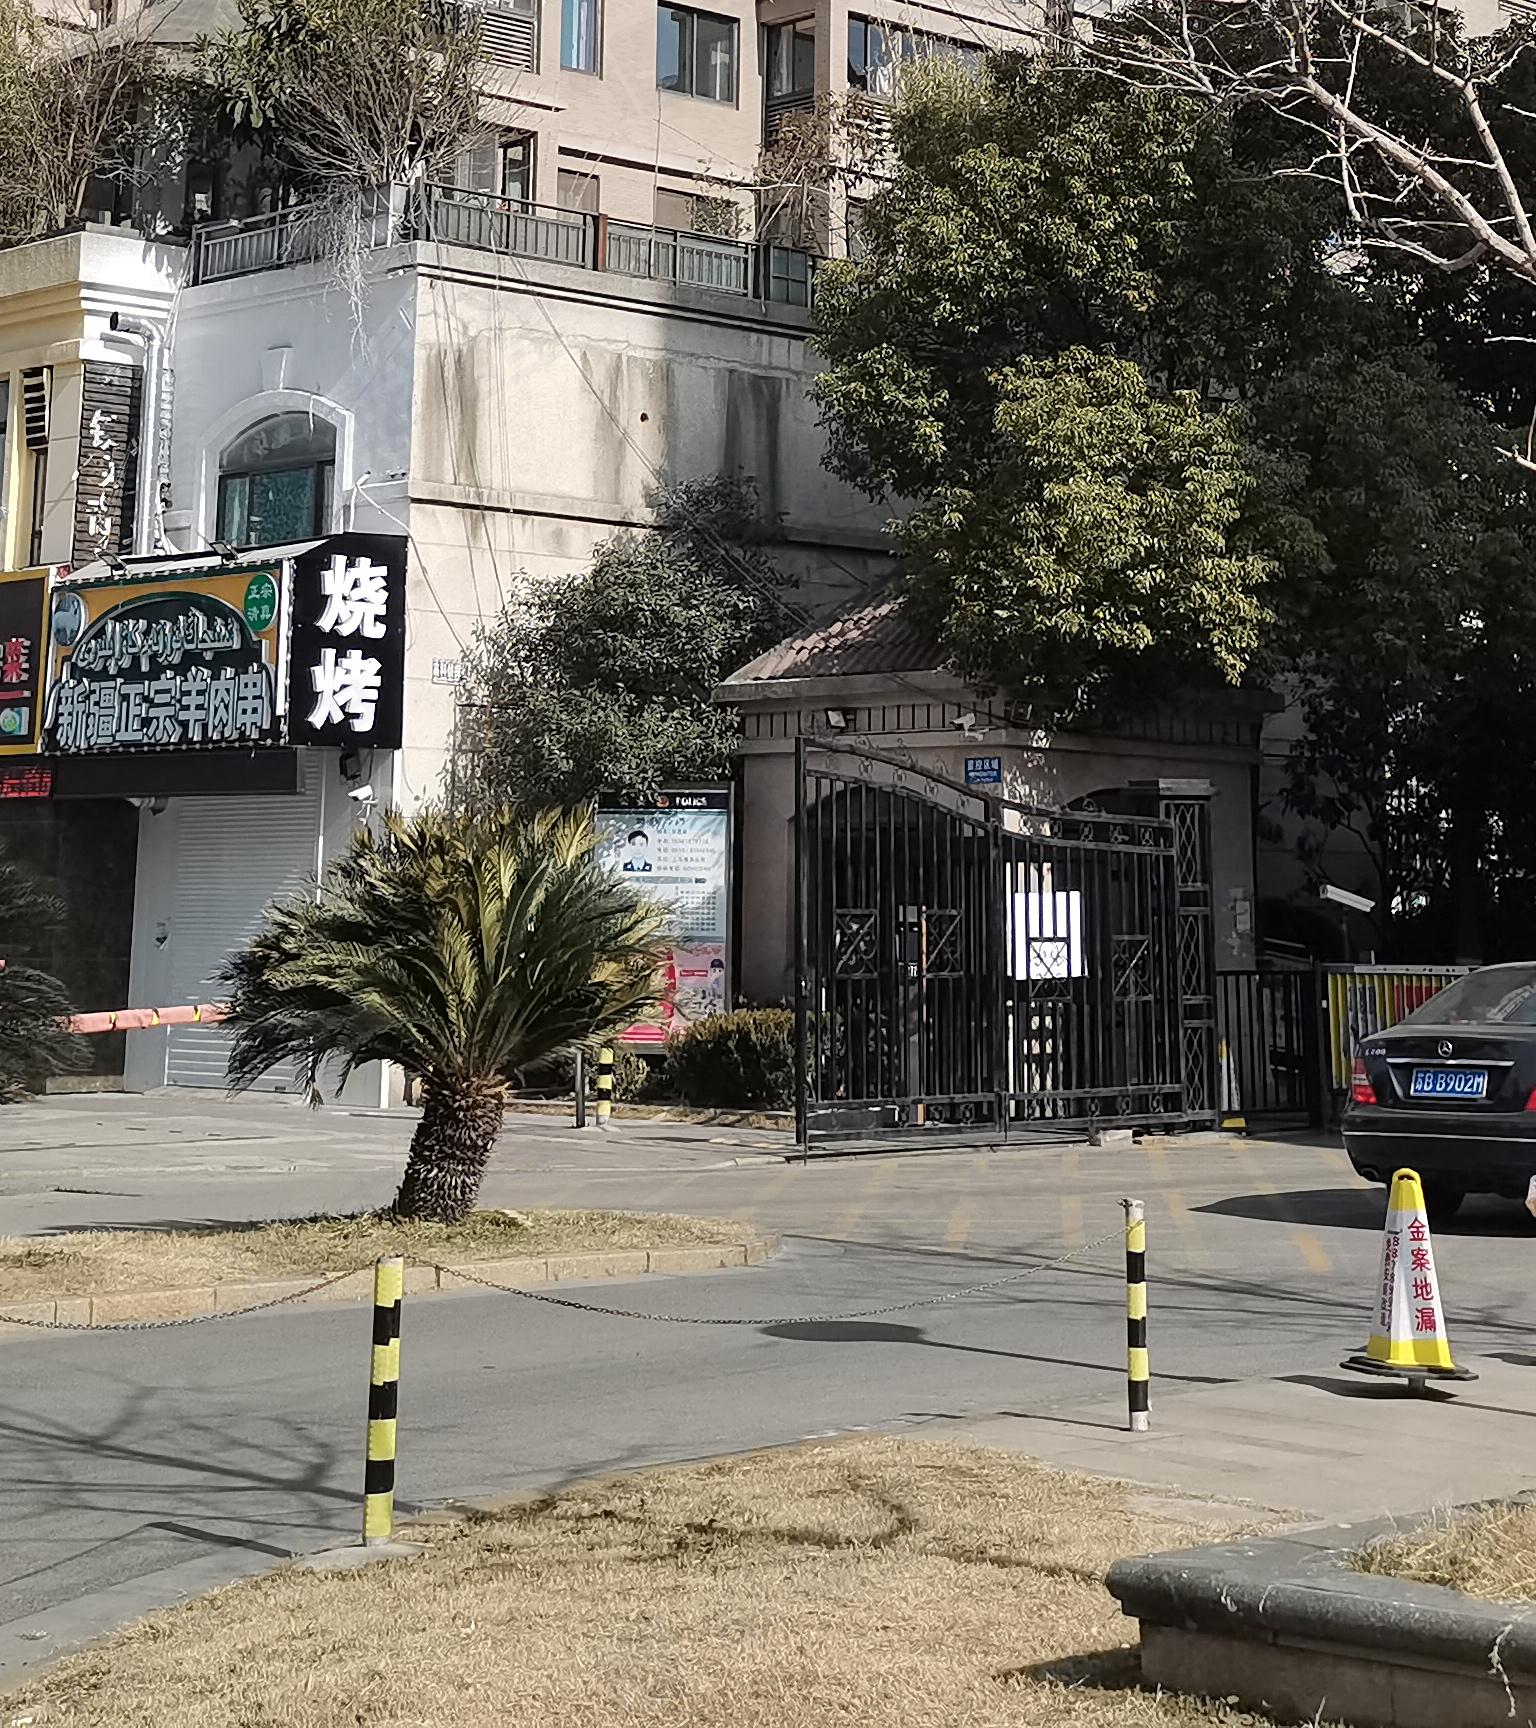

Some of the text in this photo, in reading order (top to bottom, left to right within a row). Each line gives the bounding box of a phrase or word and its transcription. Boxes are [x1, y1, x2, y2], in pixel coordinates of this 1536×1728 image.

[306, 553, 389, 733] 烧烤
[56, 664, 265, 748] 新疆正宗羊肉串
[1407, 1216, 1437, 1333] 金案地漏
